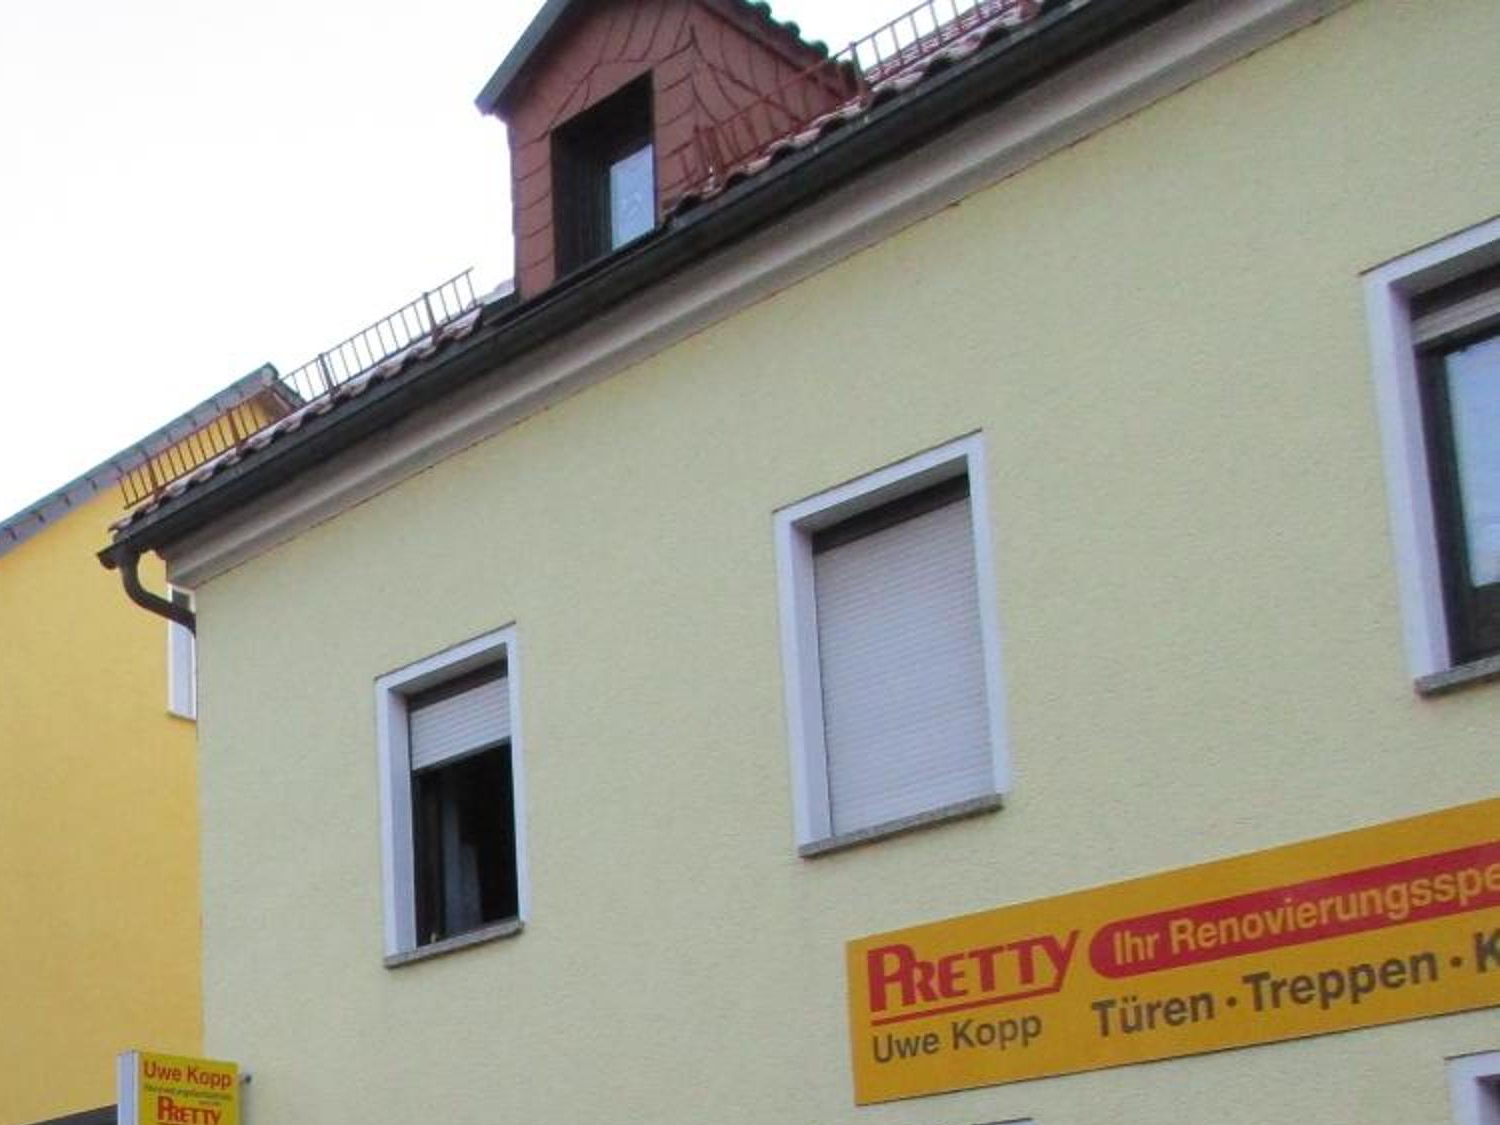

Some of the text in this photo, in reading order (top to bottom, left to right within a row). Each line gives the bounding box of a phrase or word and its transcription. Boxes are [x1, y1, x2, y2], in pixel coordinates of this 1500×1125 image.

[1113, 863, 1500, 966] Ihr Renovierungsspe
[866, 928, 1080, 1013] PRETTY
[1091, 991, 1216, 1038] Türen
[1241, 949, 1439, 1013] Treppen
[143, 1060, 233, 1091] Uwe Kopp
[872, 1013, 1043, 1064] Uwe Kopp
